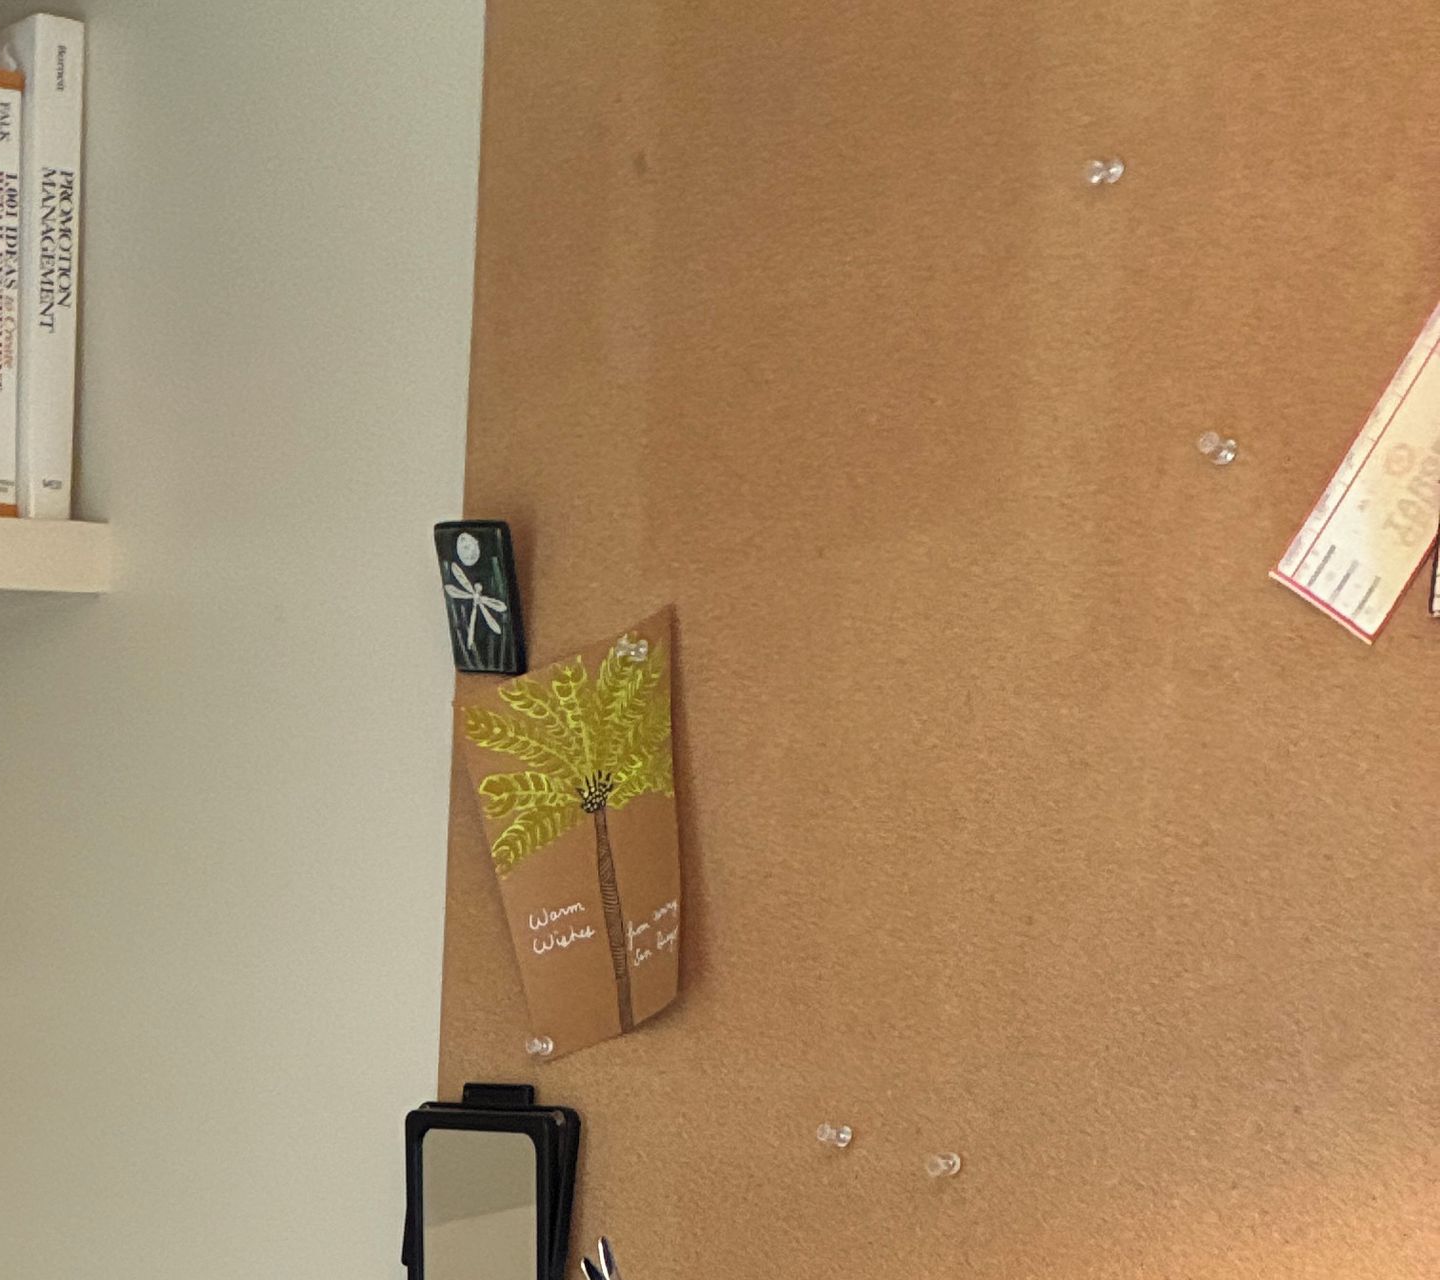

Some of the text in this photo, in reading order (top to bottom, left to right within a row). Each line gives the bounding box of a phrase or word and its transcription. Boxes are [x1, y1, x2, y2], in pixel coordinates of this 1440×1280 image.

[3, 223, 20, 290] IDEAS
[38, 167, 57, 333] MANAGEMENT
[57, 170, 75, 308] PROMOTION
[529, 901, 586, 931] Warm
[532, 925, 596, 955] Wishes
